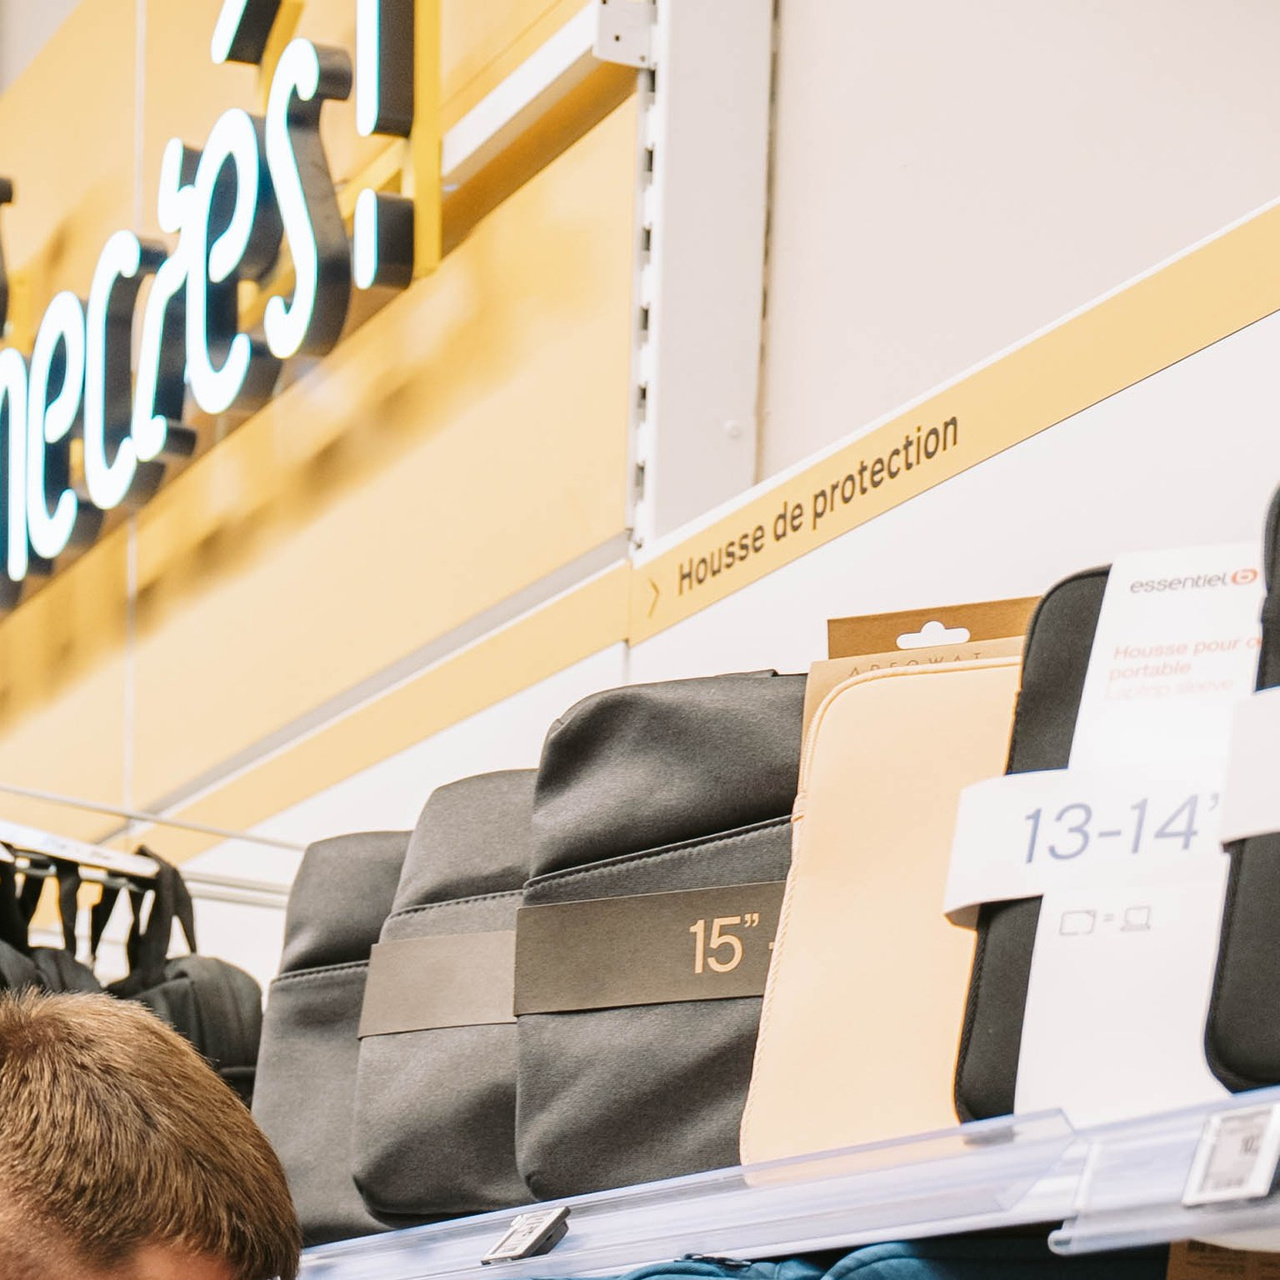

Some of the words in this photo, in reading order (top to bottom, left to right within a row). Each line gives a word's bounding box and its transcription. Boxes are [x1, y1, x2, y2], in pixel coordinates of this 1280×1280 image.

[677, 524, 765, 596] Housse
[773, 500, 804, 542] de
[812, 415, 959, 530] protection
[1113, 642, 1188, 661] Housse
[1192, 637, 1240, 657] pour
[689, 912, 760, 974] 15”
